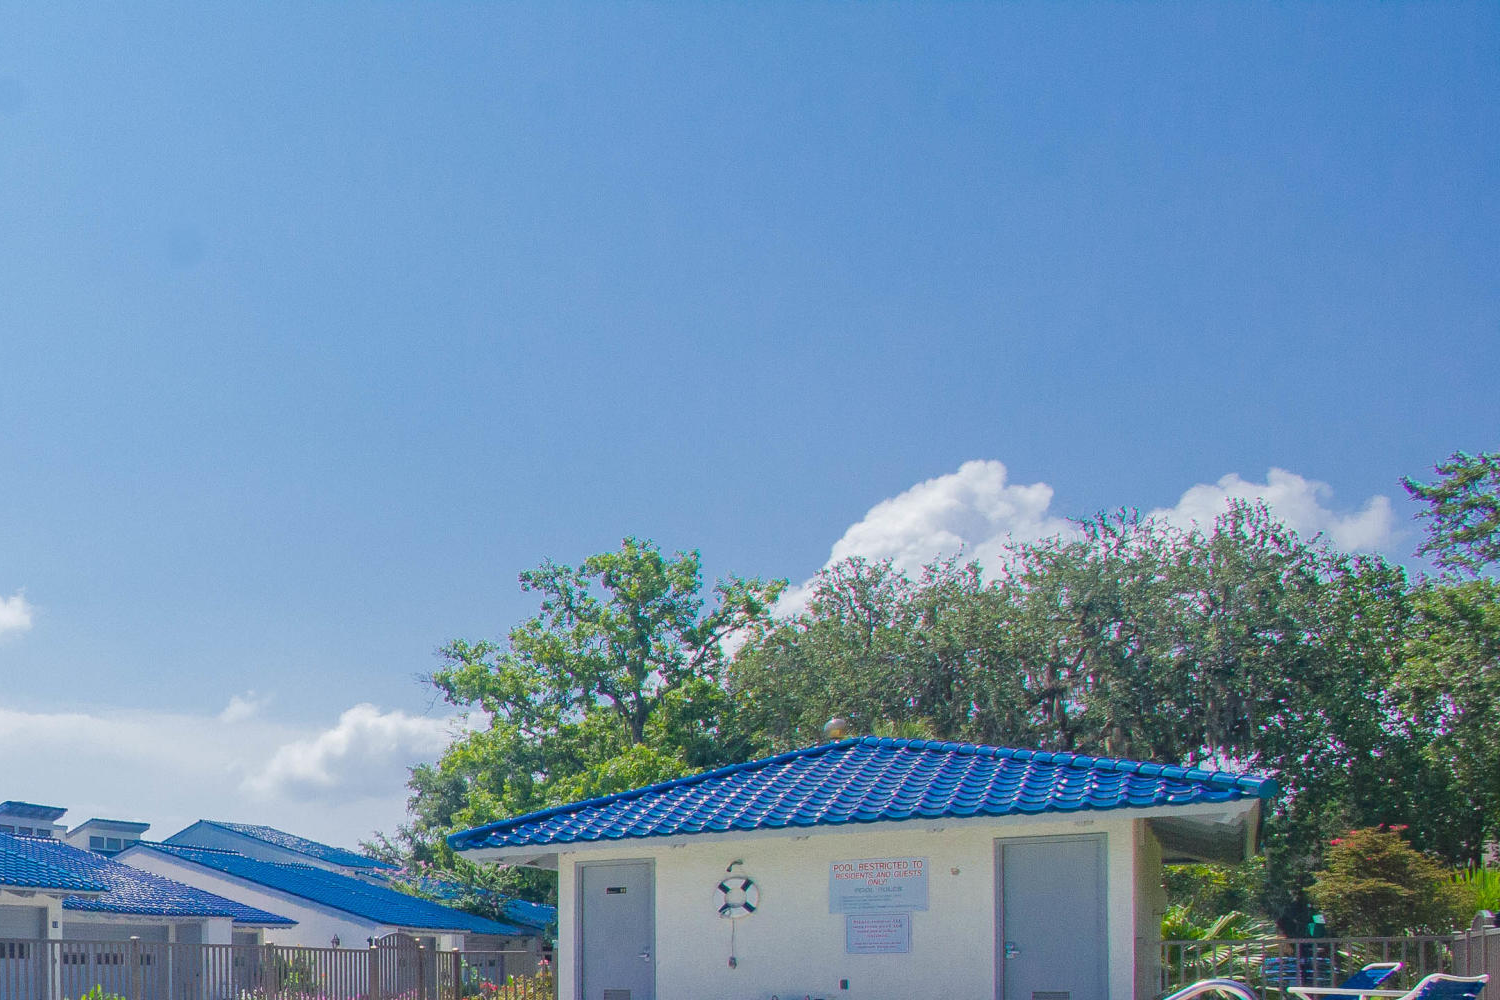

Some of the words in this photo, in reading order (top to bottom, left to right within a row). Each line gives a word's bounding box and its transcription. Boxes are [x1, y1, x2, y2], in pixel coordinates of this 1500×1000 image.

[833, 864, 854, 872] POOL
[858, 861, 908, 871] RESTRICTED
[912, 860, 923, 869] TO
[835, 872, 873, 880] RESIDENTS
[894, 870, 922, 878] GUESTS
